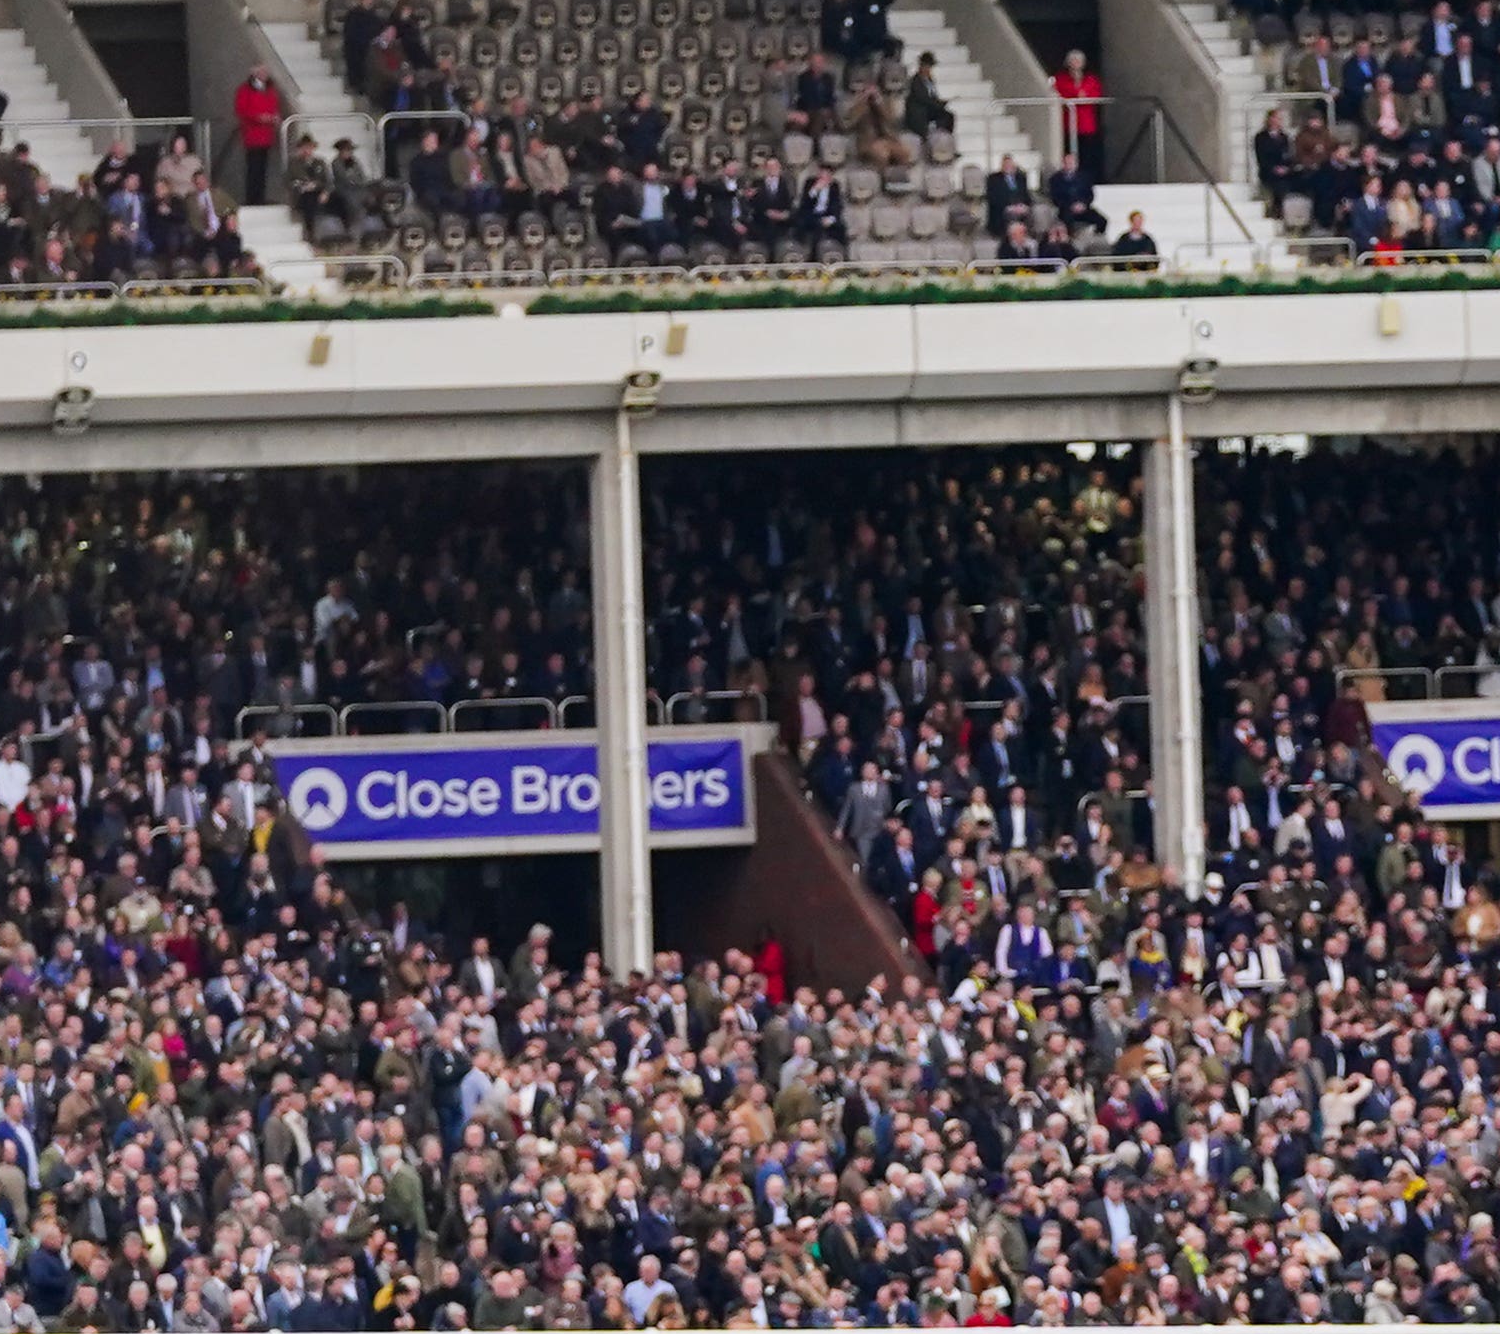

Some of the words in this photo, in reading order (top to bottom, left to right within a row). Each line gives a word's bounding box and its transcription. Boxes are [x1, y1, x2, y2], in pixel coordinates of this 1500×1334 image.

[640, 334, 655, 354] P
[356, 769, 501, 821] Close
[511, 765, 730, 814] Broers
